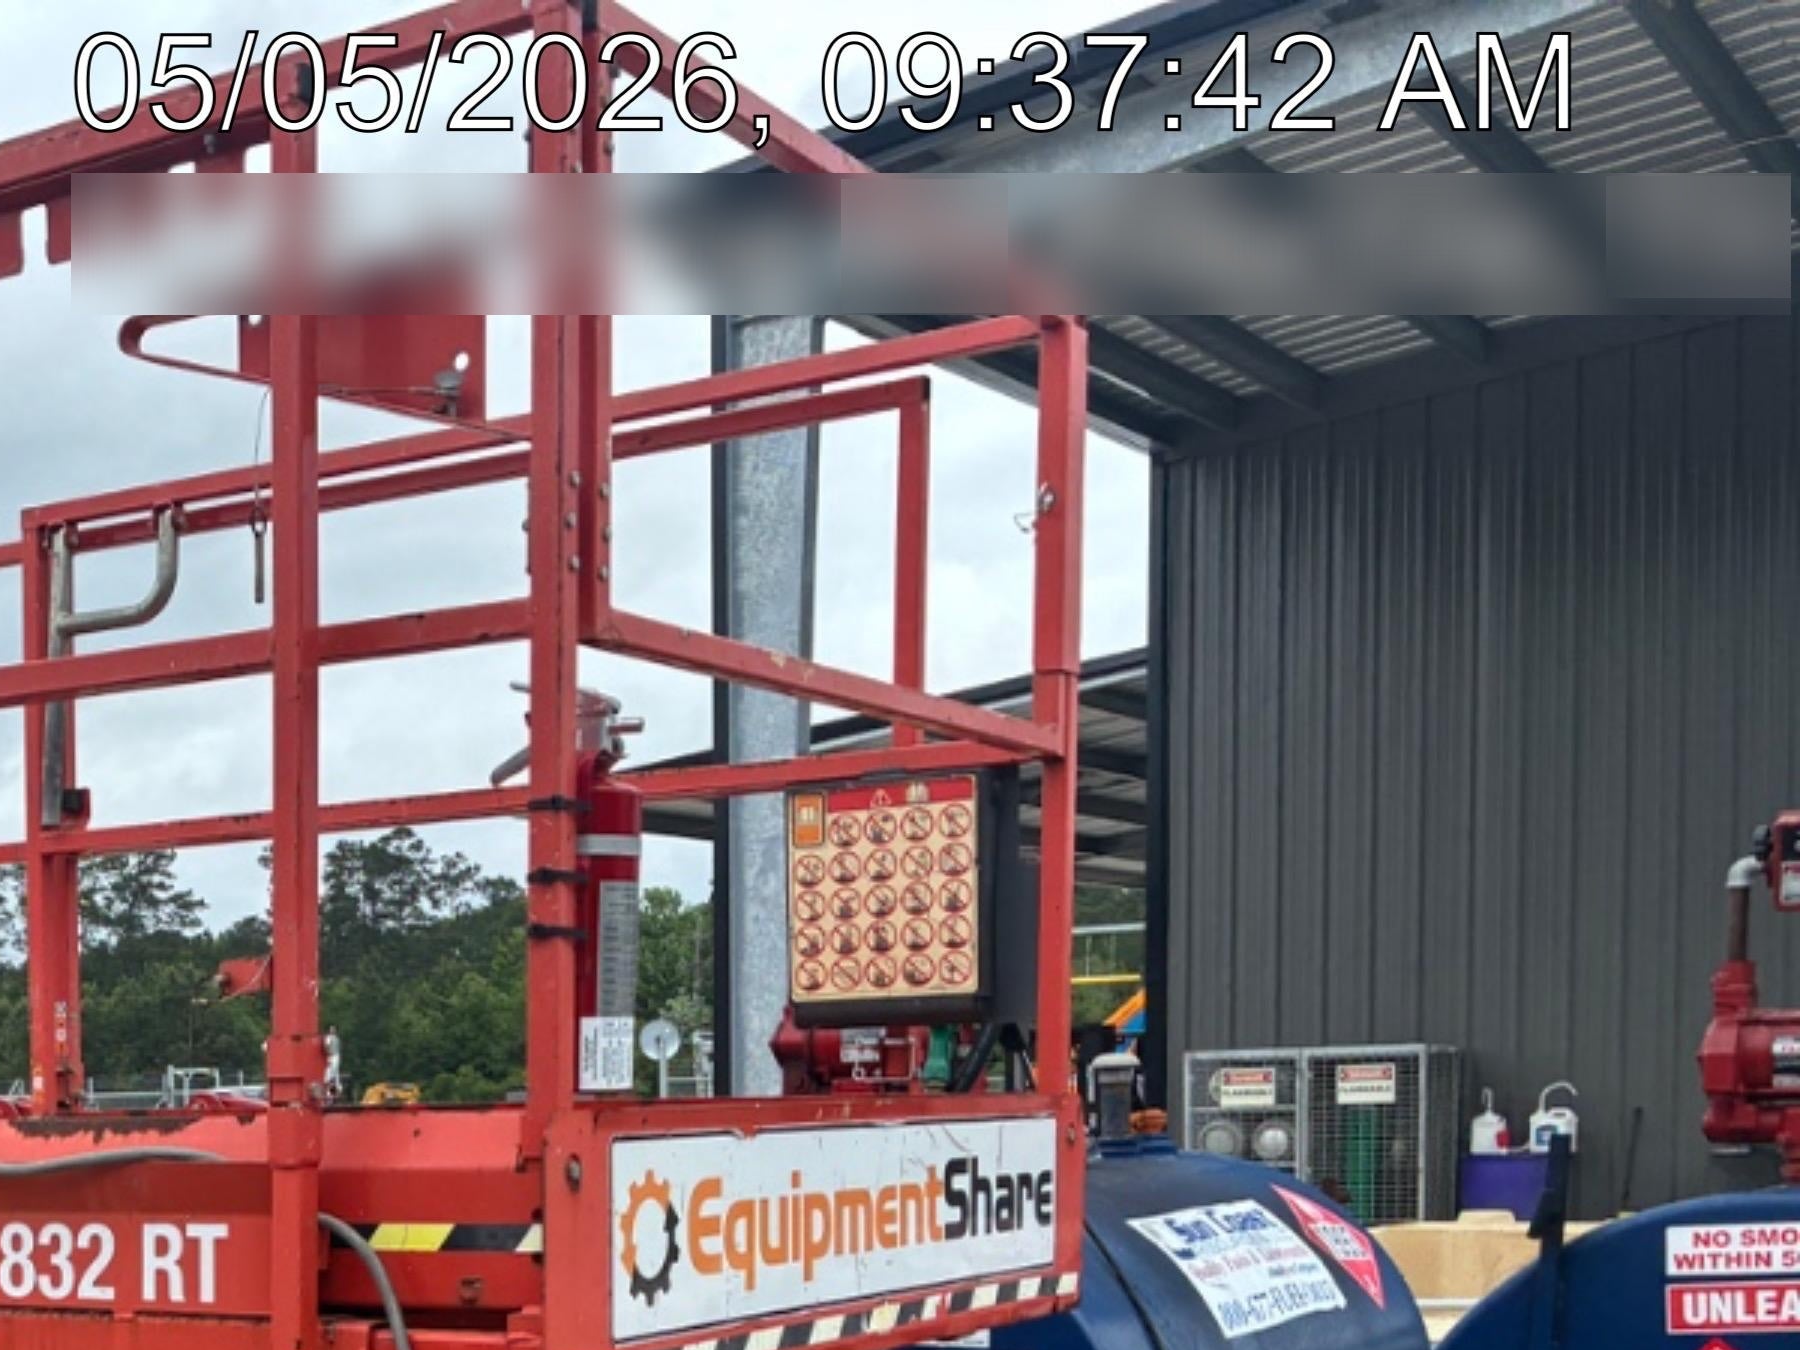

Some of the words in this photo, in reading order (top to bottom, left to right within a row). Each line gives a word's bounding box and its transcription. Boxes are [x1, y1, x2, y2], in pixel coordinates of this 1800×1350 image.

[687, 1156, 1054, 1291] EquipmentShare
[1692, 1230, 1732, 1248] NO
[1740, 1228, 1800, 1247] SMO
[141, 1222, 230, 1304] RT
[1673, 1251, 1773, 1270] WITHIN
